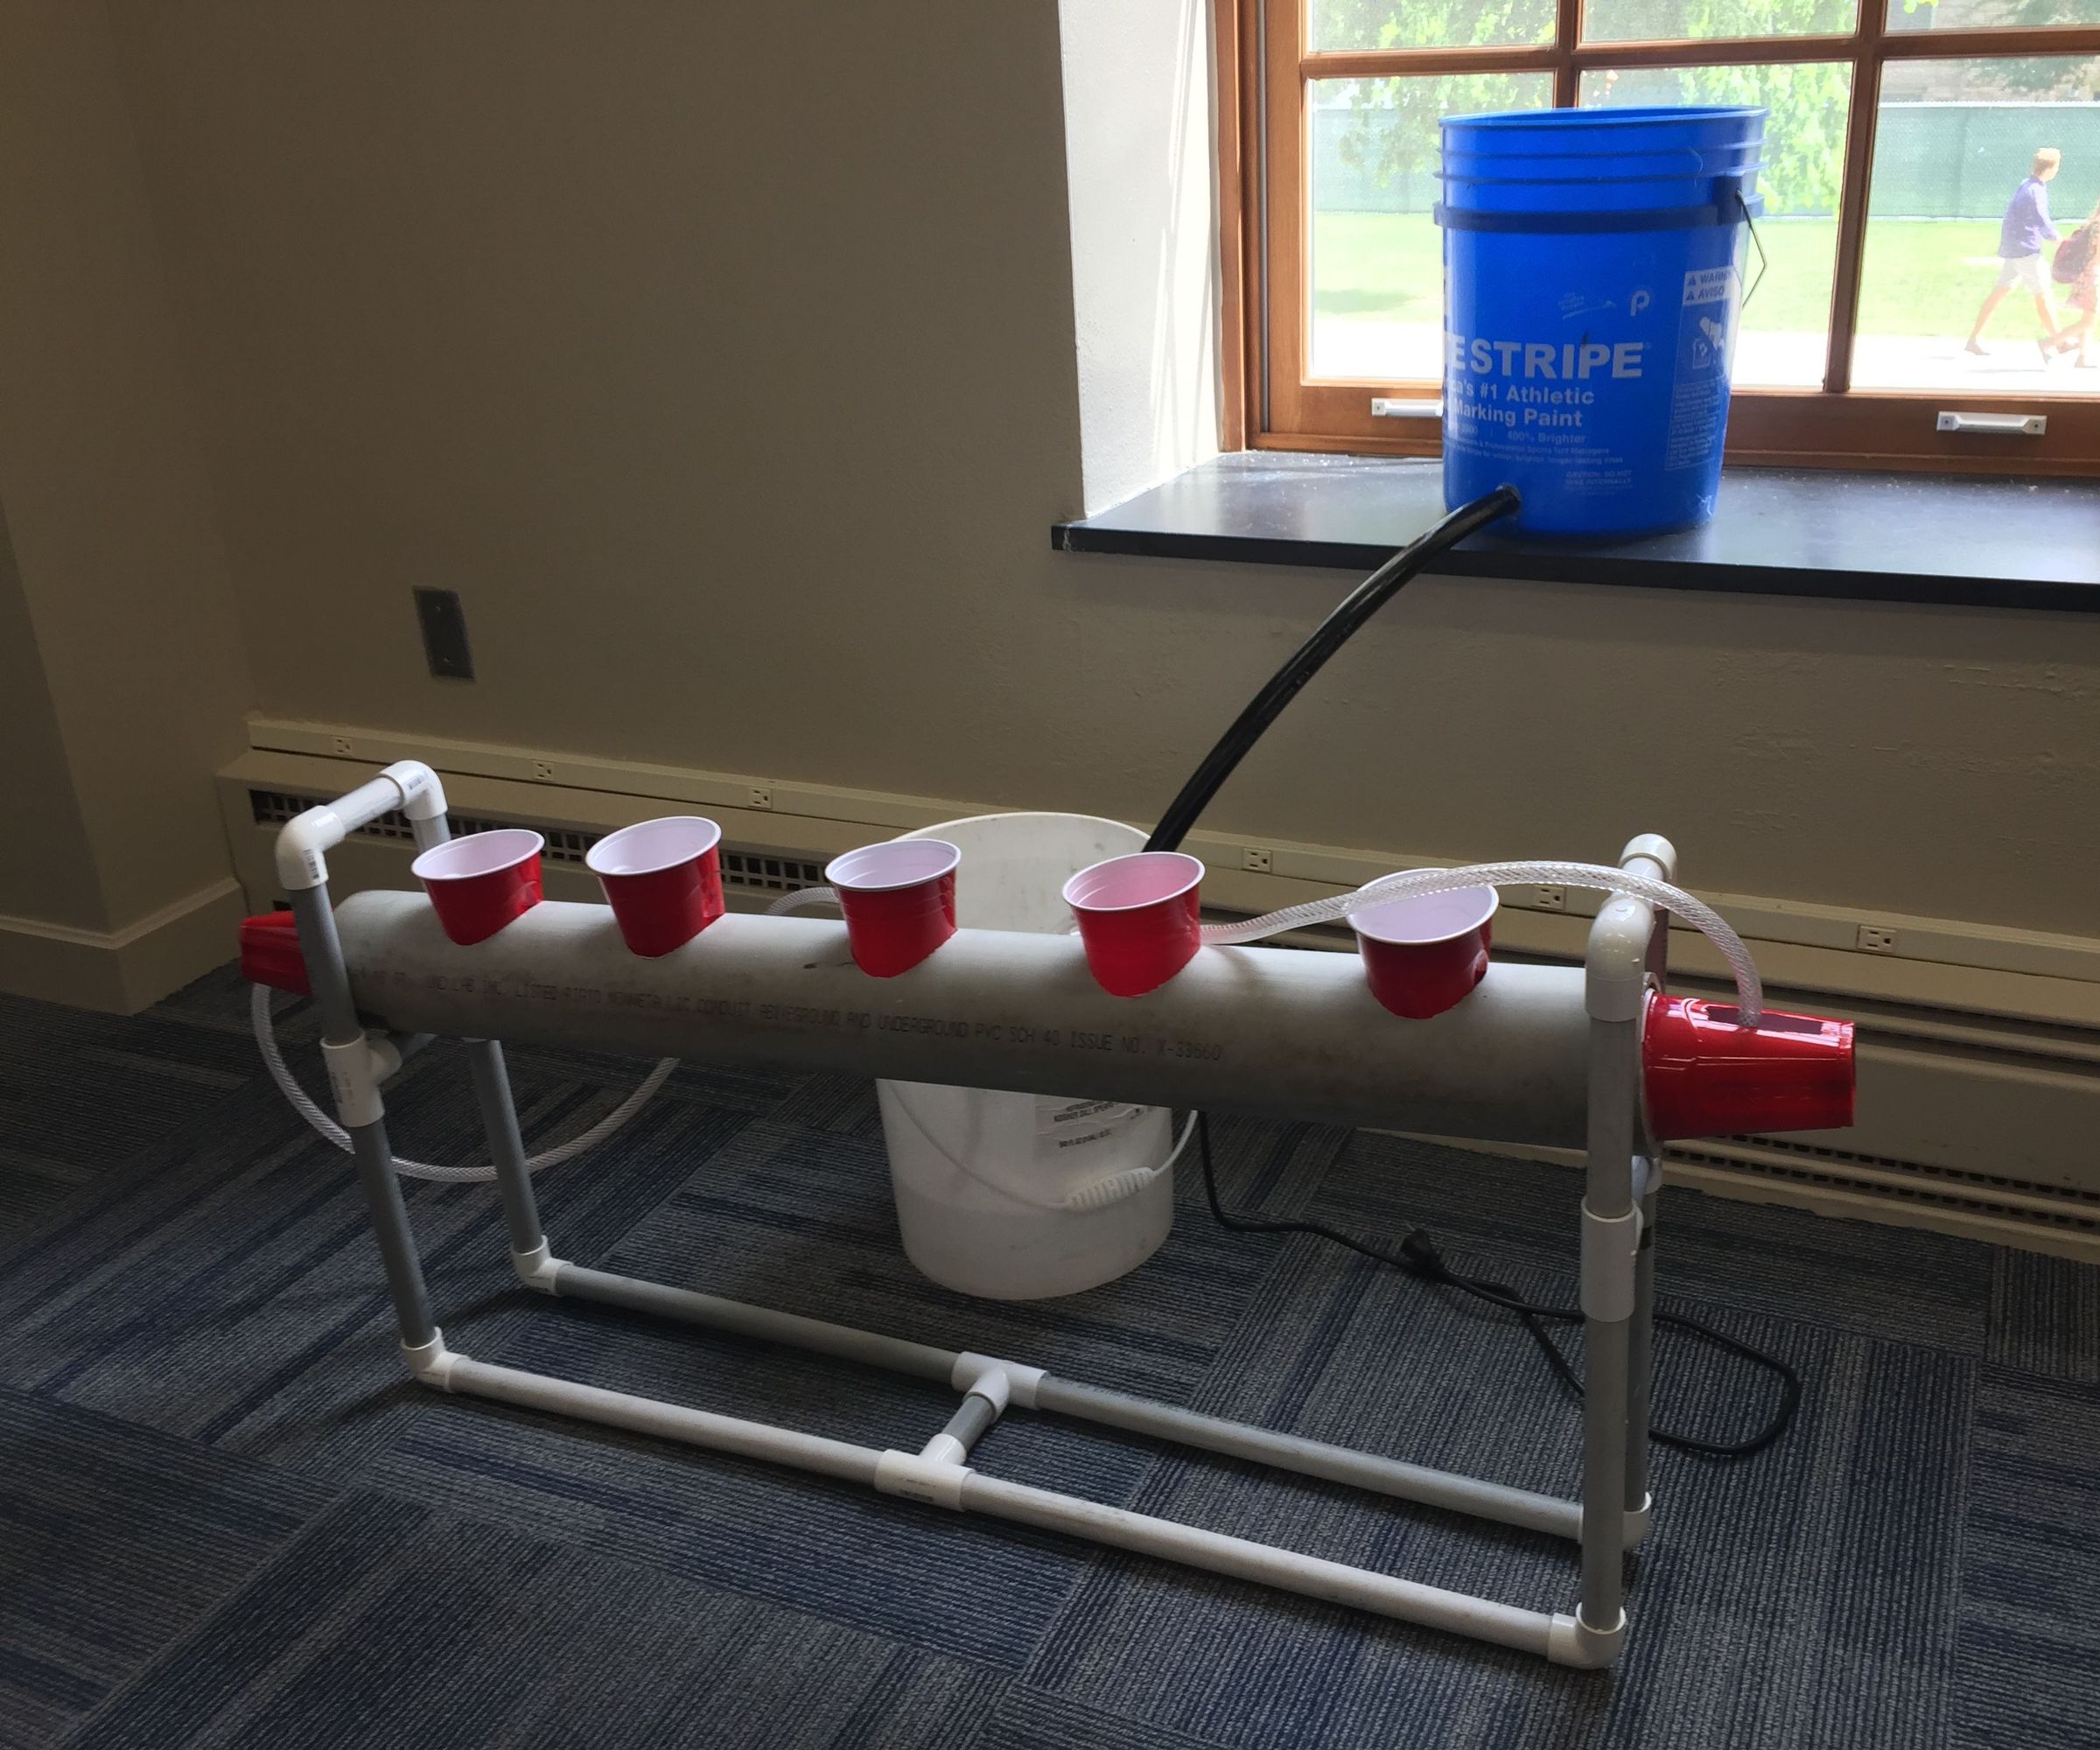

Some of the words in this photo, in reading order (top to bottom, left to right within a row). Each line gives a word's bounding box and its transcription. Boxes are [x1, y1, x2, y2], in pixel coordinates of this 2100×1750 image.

[1698, 285, 1725, 299] AVISO
[1480, 382, 1497, 400] #1
[1507, 384, 1595, 405] Athletic
[1524, 408, 1583, 428] Paint
[878, 1014, 969, 1039] UNDERGROUND
[974, 1021, 1002, 1041] PVC
[1009, 1025, 1036, 1044] SCH
[1043, 1029, 1060, 1046] 40
[1070, 1030, 1113, 1052] ISSUE
[1121, 1034, 1146, 1055] NO.
